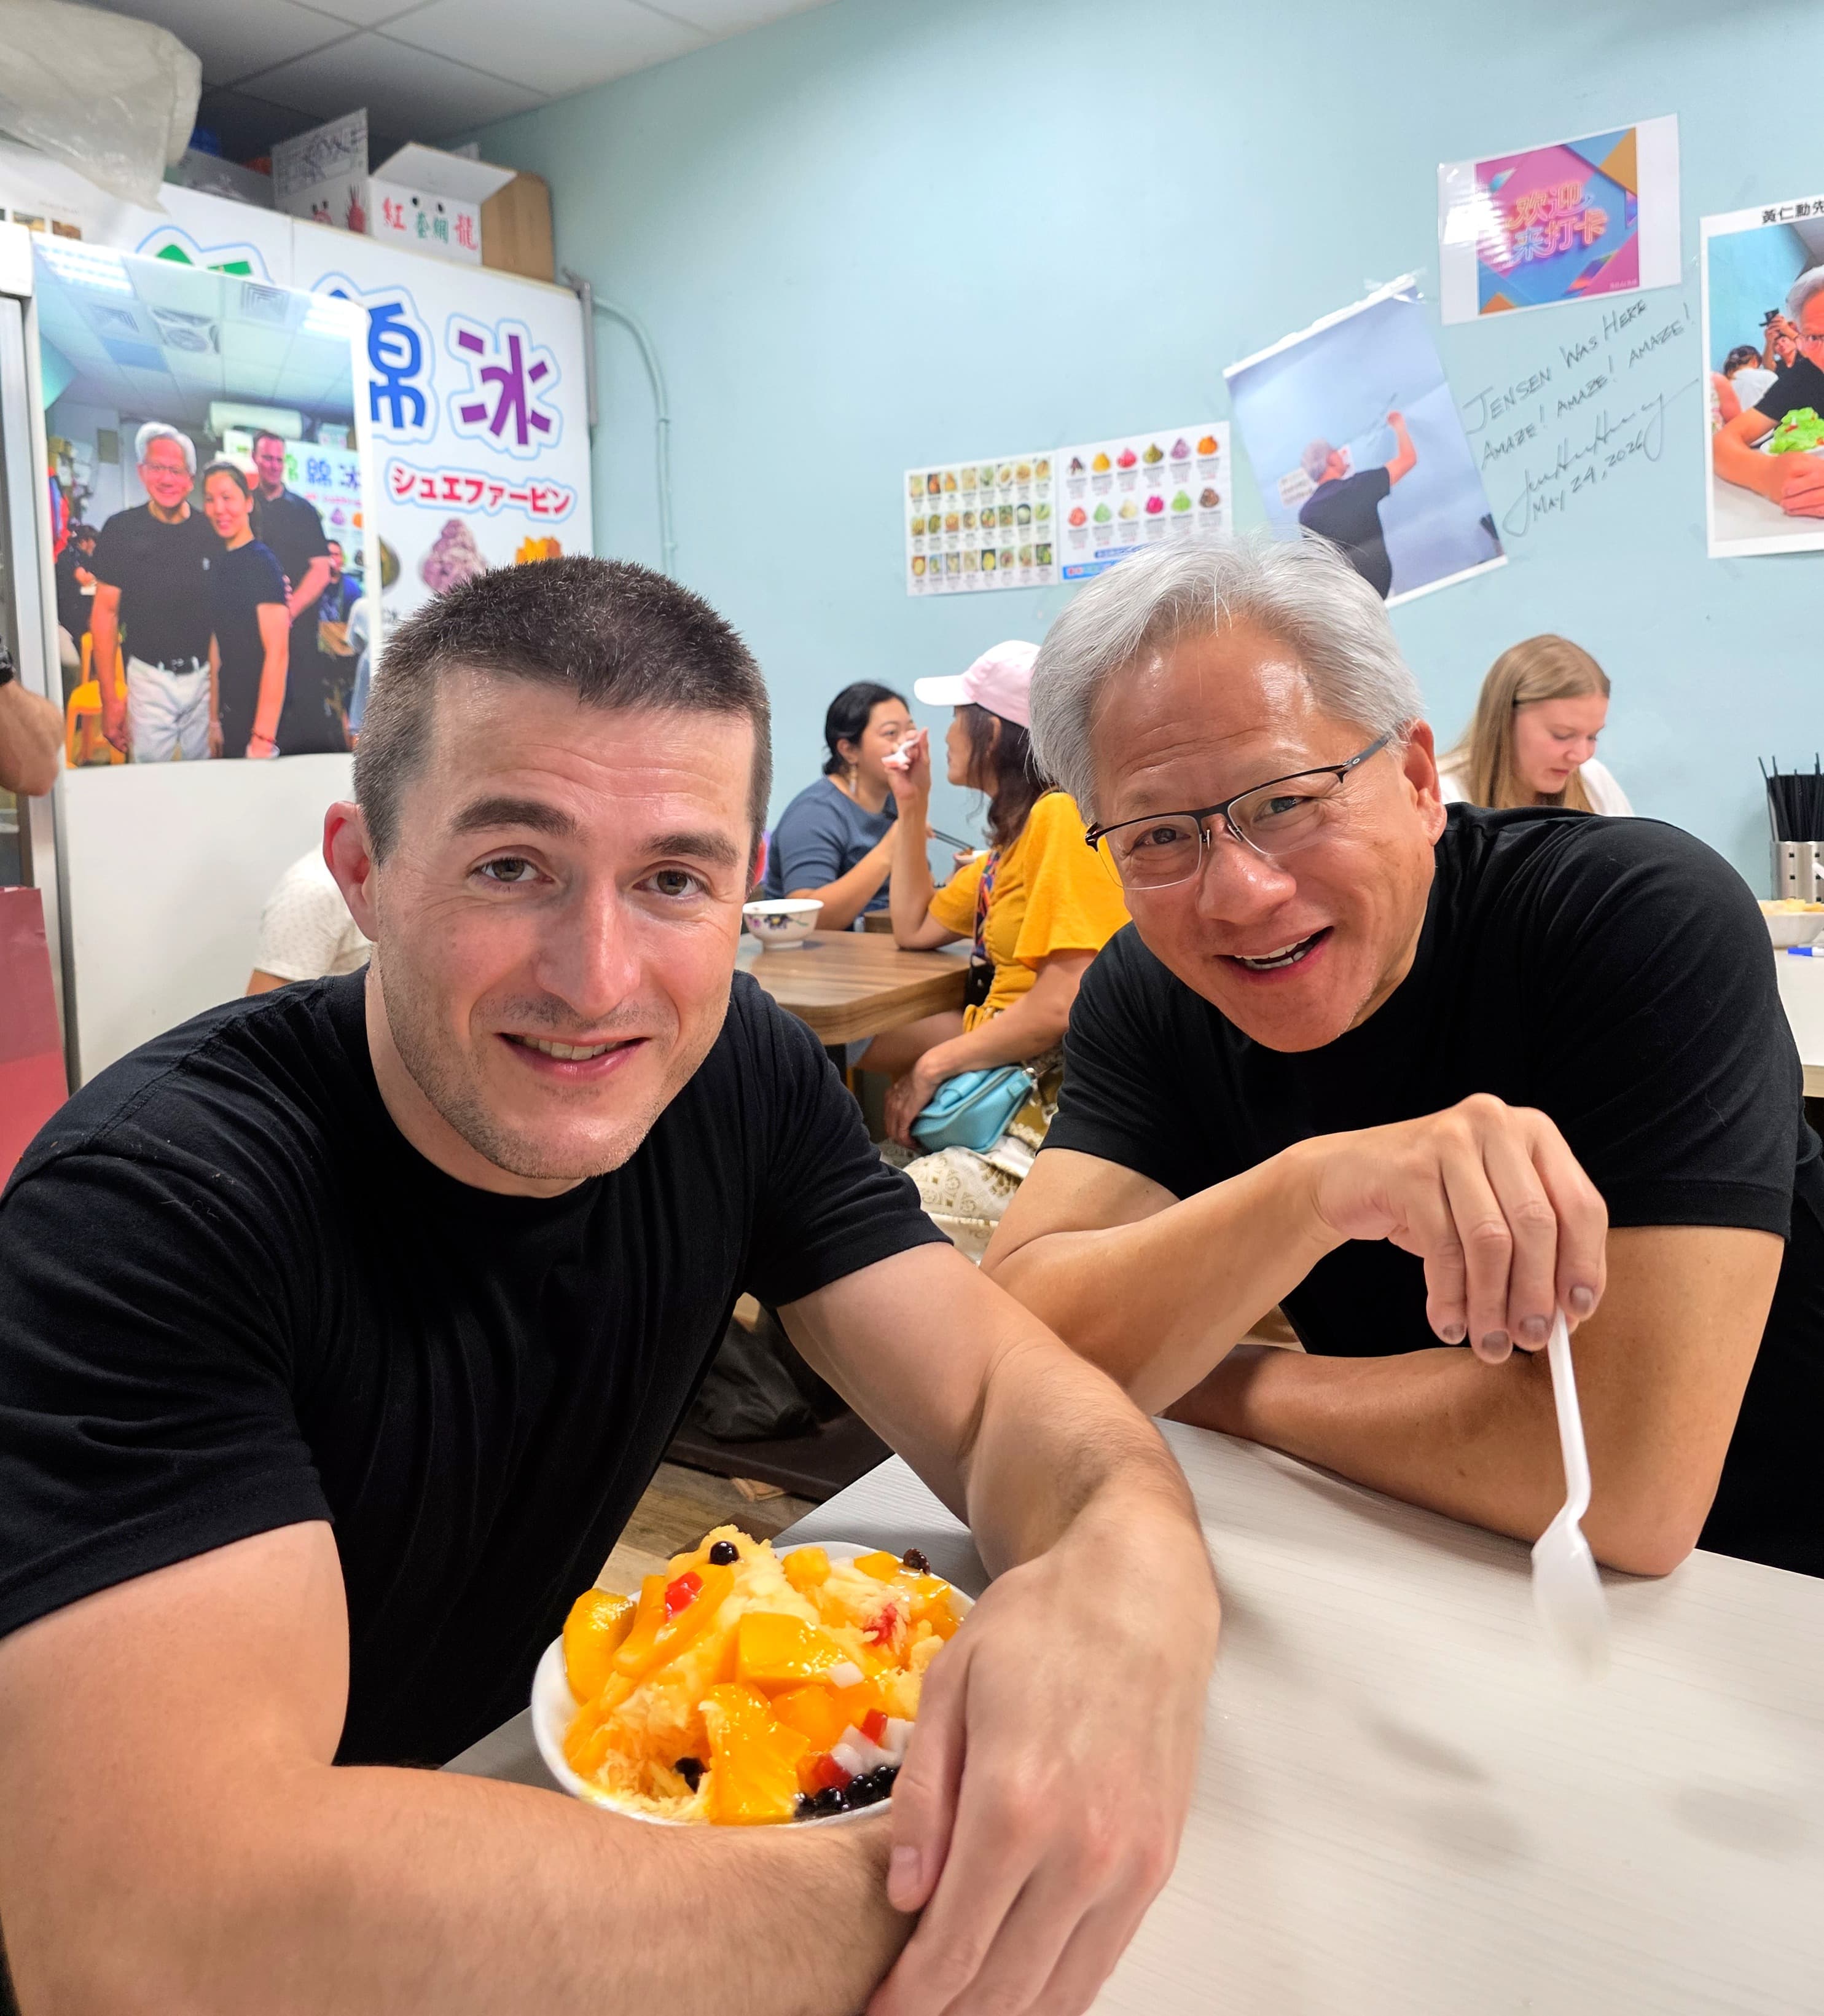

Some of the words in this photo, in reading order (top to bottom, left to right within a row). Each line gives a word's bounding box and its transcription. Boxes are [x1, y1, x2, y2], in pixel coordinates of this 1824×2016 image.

[1505, 183, 1593, 230] 欢迎
[1508, 209, 1607, 262] 来打卡
[1463, 367, 1552, 435] JENSEN
[1602, 299, 1648, 340] HERE
[1605, 429, 1645, 467] 2026
[393, 466, 571, 514] シュエファービン
